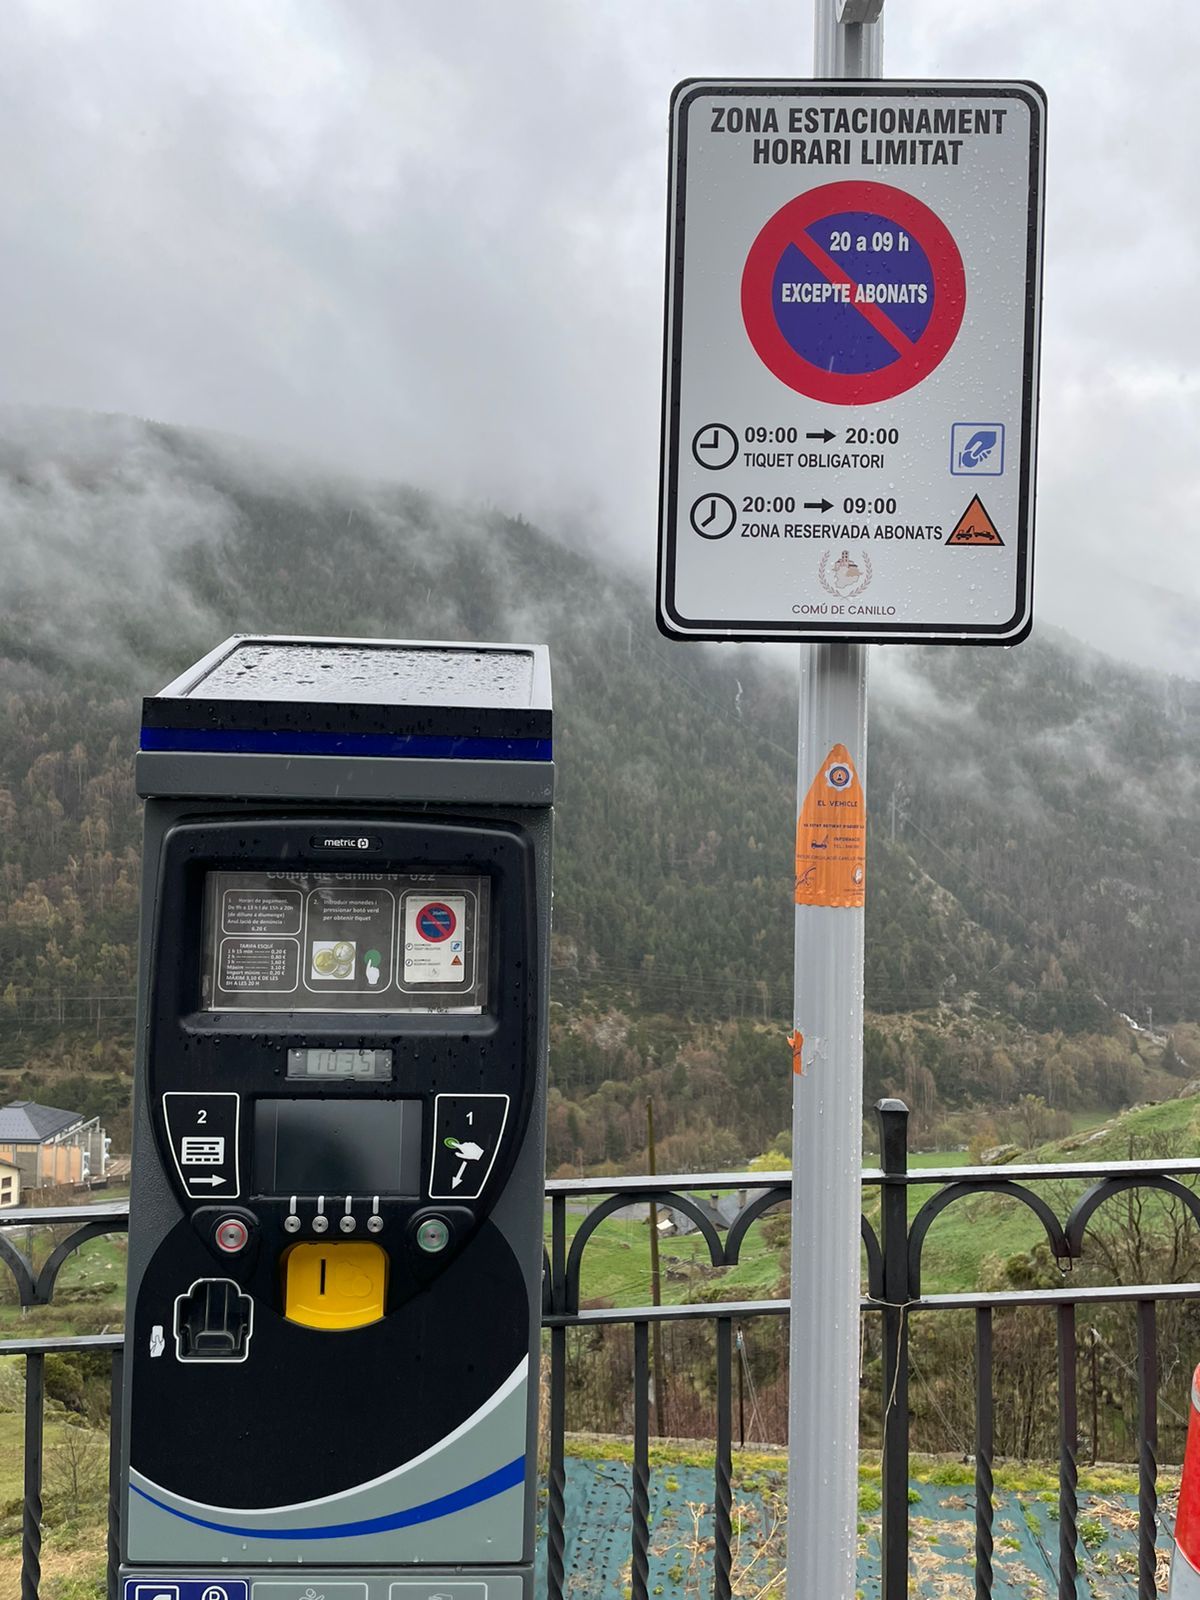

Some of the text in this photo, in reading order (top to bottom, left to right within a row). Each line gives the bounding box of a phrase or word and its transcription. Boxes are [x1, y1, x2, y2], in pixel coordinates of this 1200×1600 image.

[711, 107, 1007, 134] ZONA ESTACIONAMENT
[753, 139, 963, 165] HORARI LIMITAT
[830, 232, 909, 252] 20 a 09 h
[782, 283, 927, 304] EXCEPTE ABONATS
[744, 427, 899, 444] 09:00 20:00
[744, 453, 884, 469] TIQUET OBLIGATORI
[742, 497, 896, 514] 20:00 09:00
[741, 524, 943, 540] ZONA RESERVADA ABONATS
[792, 602, 896, 616] COMÚ DE CANILLO
[324, 838, 356, 847] metric
[196, 1109, 207, 1124] 2
[465, 1111, 474, 1125] 1
